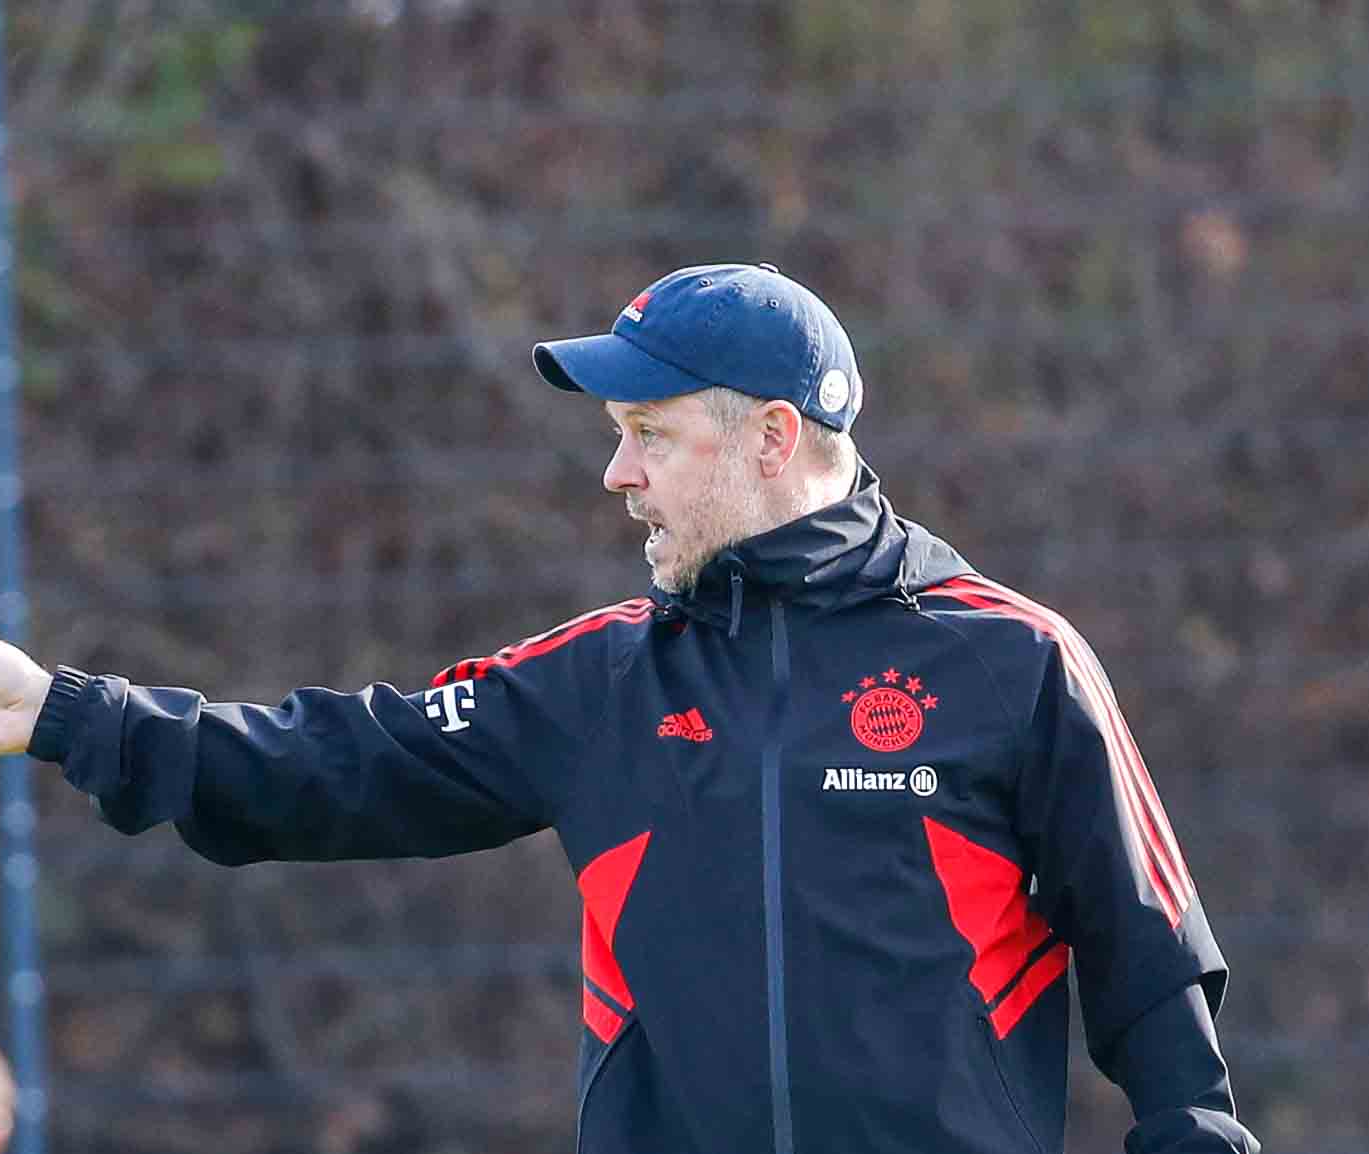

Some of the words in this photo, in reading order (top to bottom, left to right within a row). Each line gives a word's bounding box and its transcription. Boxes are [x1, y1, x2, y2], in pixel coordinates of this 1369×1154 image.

[874, 693, 916, 719] BAYERN
[657, 723, 713, 742] adidas
[822, 768, 906, 790] Allianz
